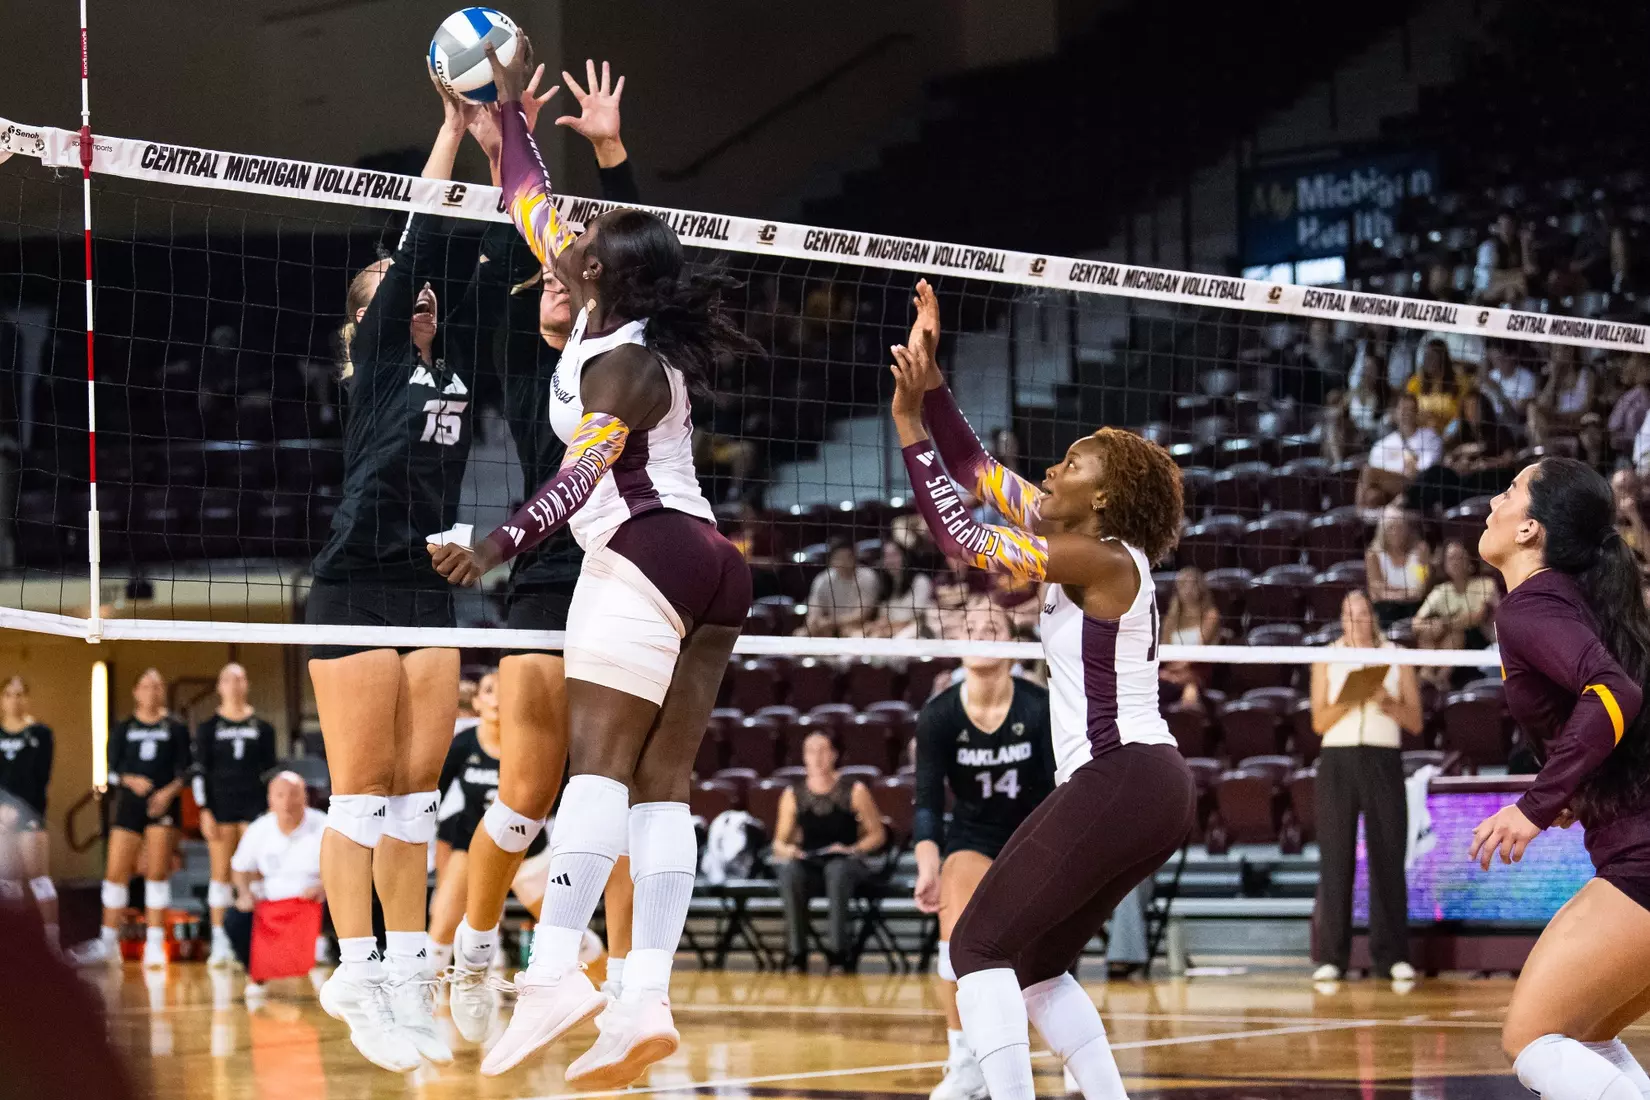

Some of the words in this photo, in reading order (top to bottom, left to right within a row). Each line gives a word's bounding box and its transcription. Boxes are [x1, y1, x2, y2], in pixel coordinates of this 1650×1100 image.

[15, 128, 40, 139] Senoh
[141, 144, 218, 179] CENTRAL
[222, 156, 312, 190] MICHIGAN
[313, 166, 413, 202] VOLLEYBALL
[803, 229, 862, 256] CENTRAL
[864, 236, 930, 264] MICHIGAN
[932, 245, 1006, 274] VOLLEYBALL
[1069, 262, 1120, 286] CENTRAL
[1122, 268, 1180, 293] MICHIGAN
[1181, 276, 1246, 301] VOLLEYBALL
[1302, 289, 1347, 312] CENTRAL
[1349, 295, 1399, 318] MICHIGAN
[1400, 301, 1458, 324] VOLLEYBALL
[1506, 313, 1547, 334] CENTRAL
[1549, 319, 1594, 339] MICHIGAN
[1594, 325, 1646, 345] VOLLEYBALL
[420, 399, 468, 445] 15
[527, 448, 606, 533] CHIPPEWAS
[925, 475, 1000, 556] CHIPPEWAS
[957, 741, 1032, 766] OAKLAND
[975, 769, 1021, 799] 14
